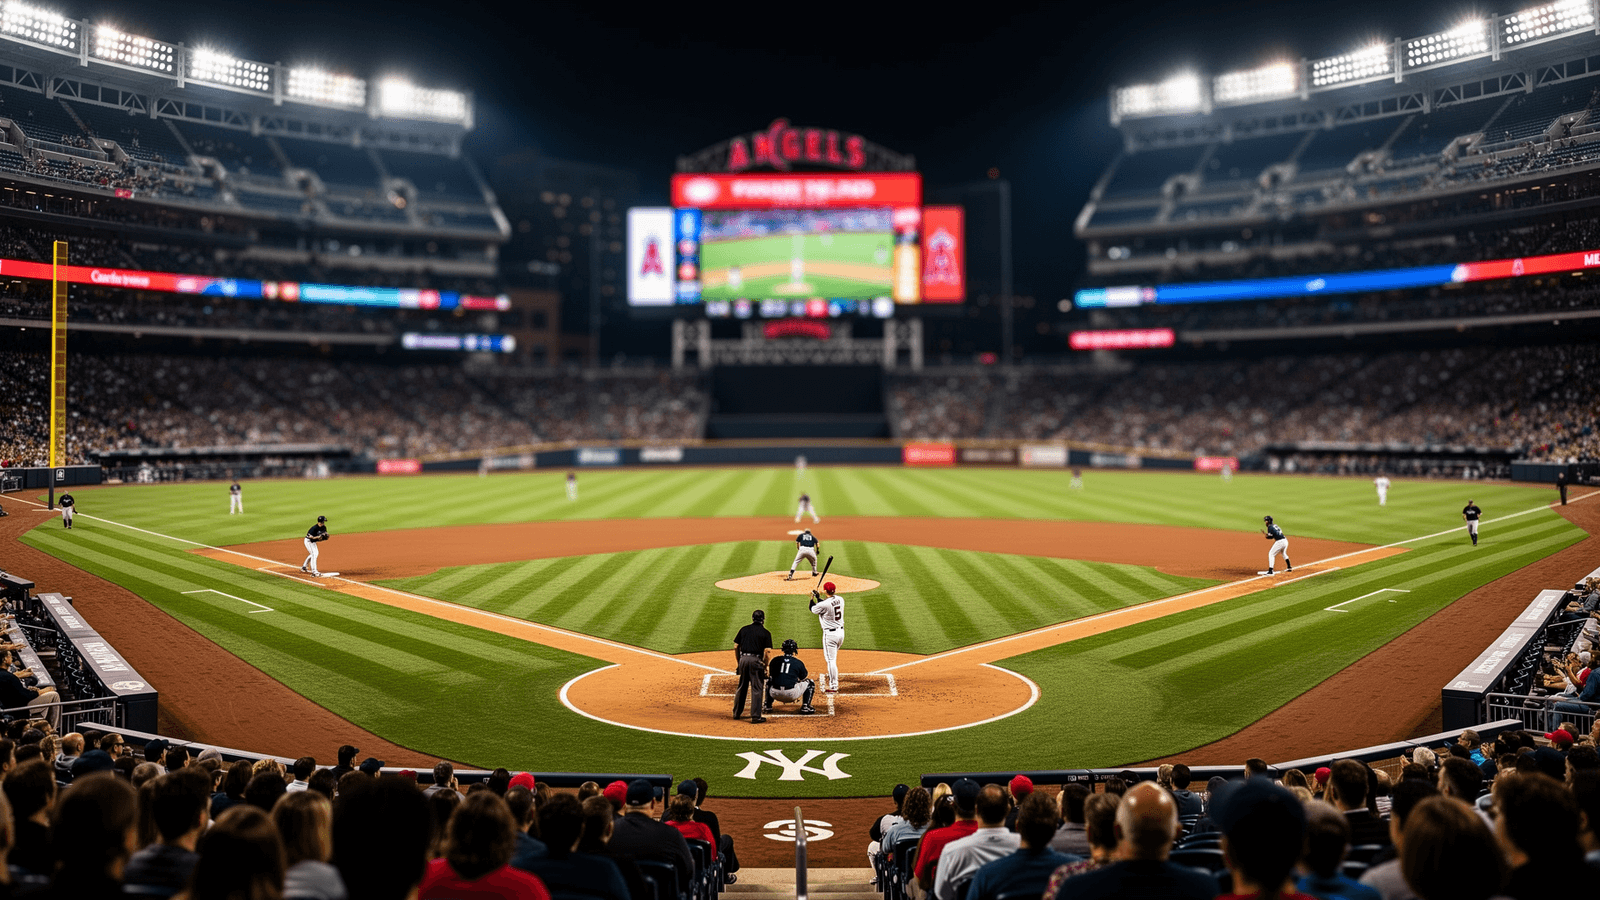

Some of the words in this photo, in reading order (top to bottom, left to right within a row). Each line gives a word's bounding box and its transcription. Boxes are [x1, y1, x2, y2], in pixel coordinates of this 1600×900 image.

[729, 119, 867, 170] ANGELS
[640, 236, 665, 277] A
[834, 606, 841, 621] 5
[780, 662, 790, 674] 11
[734, 749, 852, 780] NY
